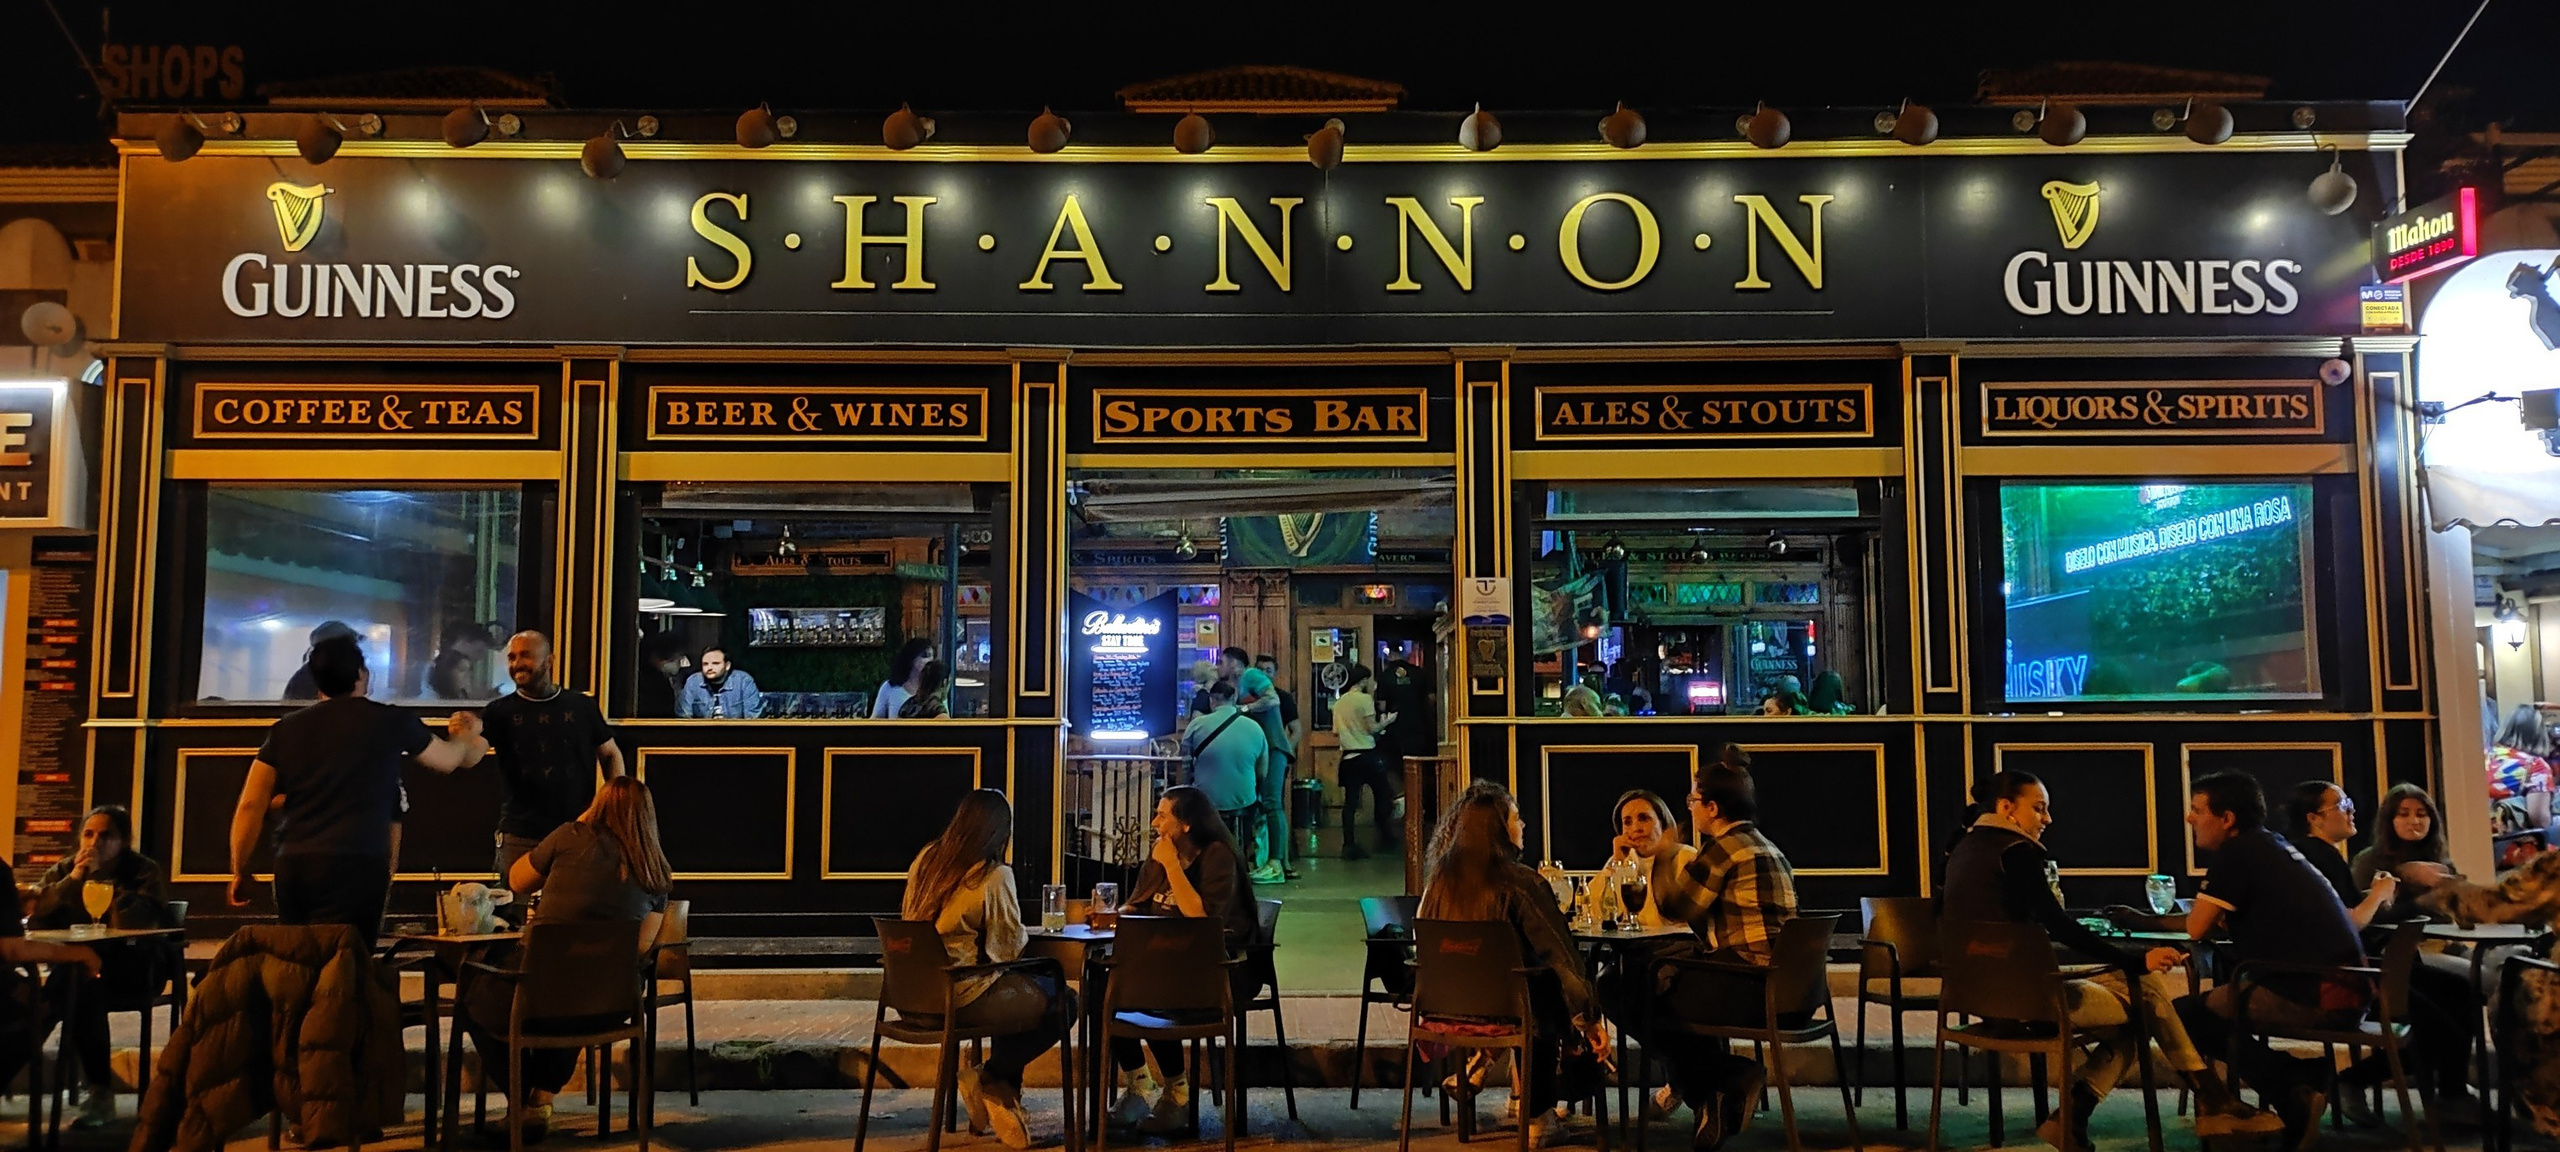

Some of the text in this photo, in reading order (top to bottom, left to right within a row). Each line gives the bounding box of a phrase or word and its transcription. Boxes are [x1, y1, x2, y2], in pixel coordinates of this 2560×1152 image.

[102, 45, 245, 99] SHOPS
[2387, 211, 2454, 254] Mahou
[2389, 238, 2455, 270] DESDE 1890
[221, 252, 518, 319] GUINNESS
[2003, 250, 2300, 315] GUINNESS
[214, 394, 523, 430] COFFEE & TEAS
[667, 396, 969, 431] BEER & WINES
[1104, 400, 1417, 432] SPORTS BAR
[1552, 394, 1857, 430] ALES & STOUTS
[1994, 389, 2309, 429] LIQUORS & SPIRITS
[2065, 544, 2096, 573] DISELO
[2096, 538, 2118, 565] CON
[2159, 520, 2197, 549] DISELO
[2199, 514, 2225, 541] CON
[2225, 505, 2253, 534] UNA
[2254, 496, 2292, 527] ROSA
[819, 555, 862, 566] TOUTS
[1378, 553, 1416, 563] AVERN
